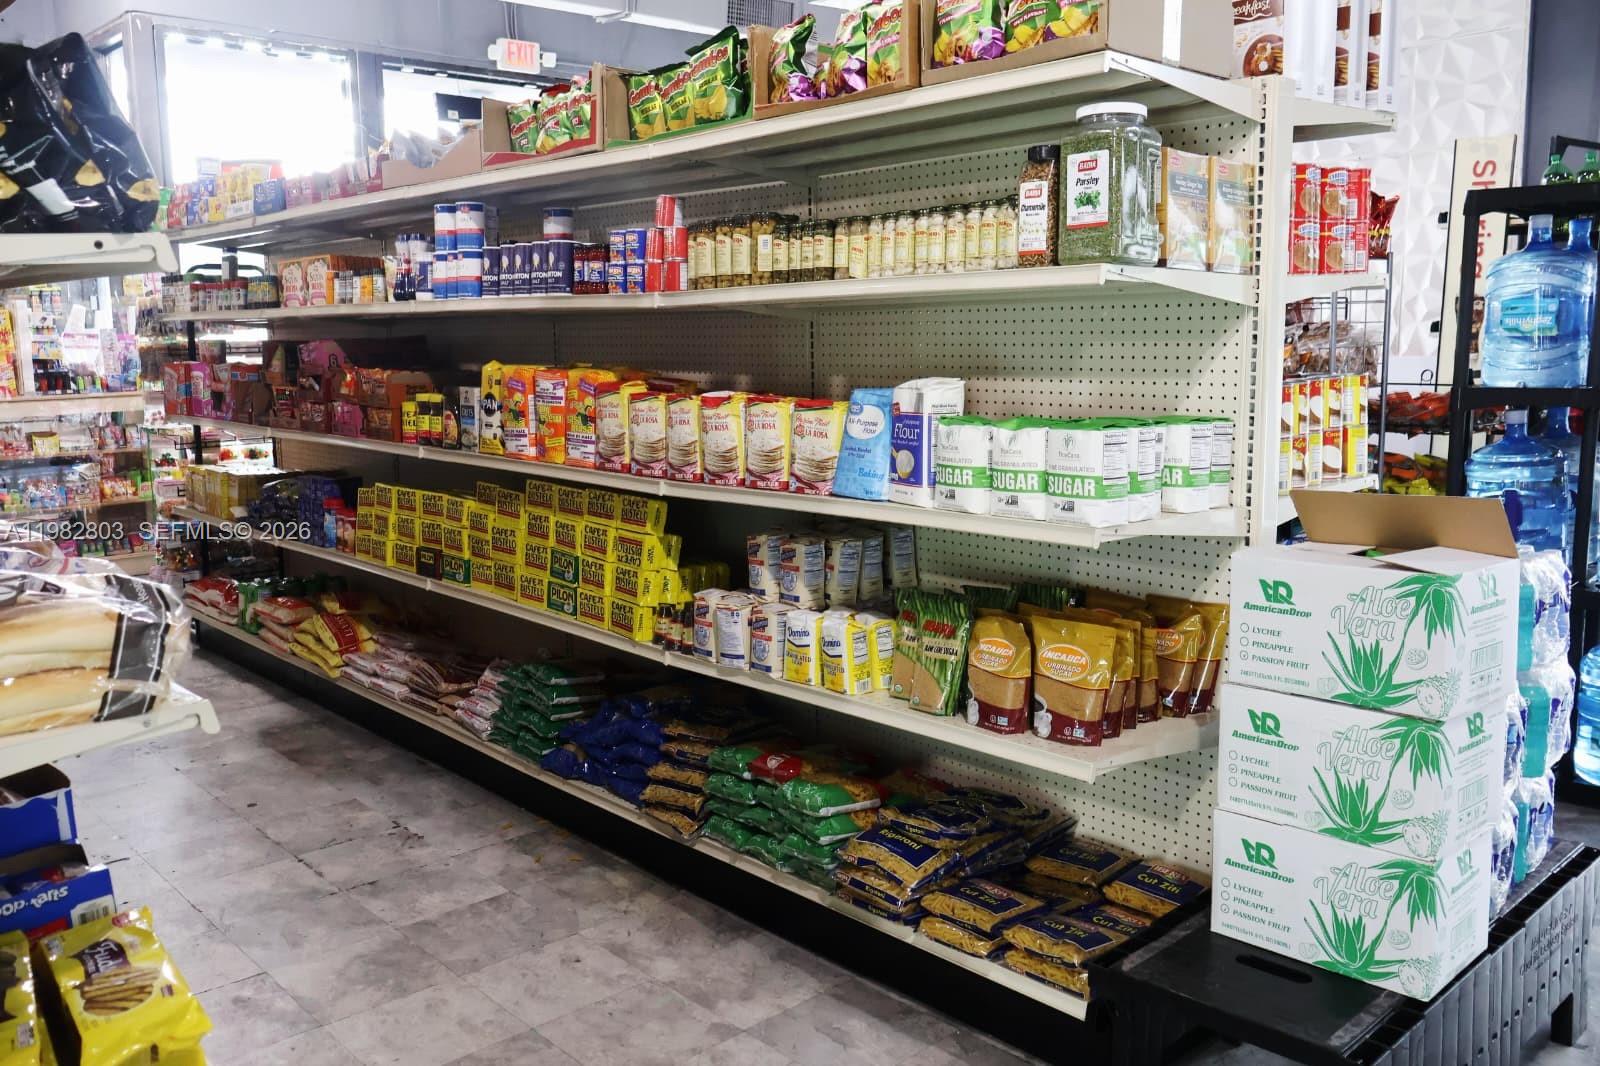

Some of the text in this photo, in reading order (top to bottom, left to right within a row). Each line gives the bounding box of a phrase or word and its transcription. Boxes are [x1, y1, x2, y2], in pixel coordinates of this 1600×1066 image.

[1232, 0, 1270, 16] eakfast
[507, 40, 536, 65] EXIT
[1076, 176, 1099, 187] Parsley
[813, 431, 828, 439] ROSA
[894, 424, 920, 440] Flour
[858, 467, 885, 481] Baking
[936, 467, 973, 486] SUGAR
[992, 471, 1039, 490] SUGAR
[1048, 475, 1096, 497] SUGAR
[492, 536, 516, 549] BUSTELO
[584, 535, 607, 549] BUSTELO
[521, 583, 544, 598] BUSTELO
[616, 577, 638, 591] BUSTELO
[1243, 601, 1312, 619] AmericanDrop
[1347, 585, 1412, 619] Aloe
[1252, 625, 1282, 637] LYCHEE
[1331, 604, 1396, 642] Vera
[788, 626, 810, 638] Domino
[1252, 640, 1294, 654] PINEAPPLE
[1042, 650, 1086, 663] INCAUCA
[1252, 655, 1310, 671] PASSION FRUIT
[1232, 729, 1300, 751] AmericanDrop
[1333, 724, 1397, 761] Aloe
[1241, 754, 1270, 768] LYCHEE
[1317, 741, 1380, 782] Vera
[1241, 768, 1281, 785] PINEAPPLE
[1241, 782, 1297, 802] PASSION FRUIT
[1224, 857, 1295, 884] AmericanDrop
[1137, 873, 1183, 895] Cut Ziti
[1330, 862, 1394, 901] Aloe
[960, 886, 979, 899] Cut
[1233, 882, 1264, 898] LYCHEE
[1314, 876, 1378, 920] Vera
[1233, 896, 1275, 914] PINEAPPLE
[1044, 919, 1065, 931] Cut
[1093, 916, 1114, 928] Cut
[1233, 909, 1292, 934] PASSION FRUIT
